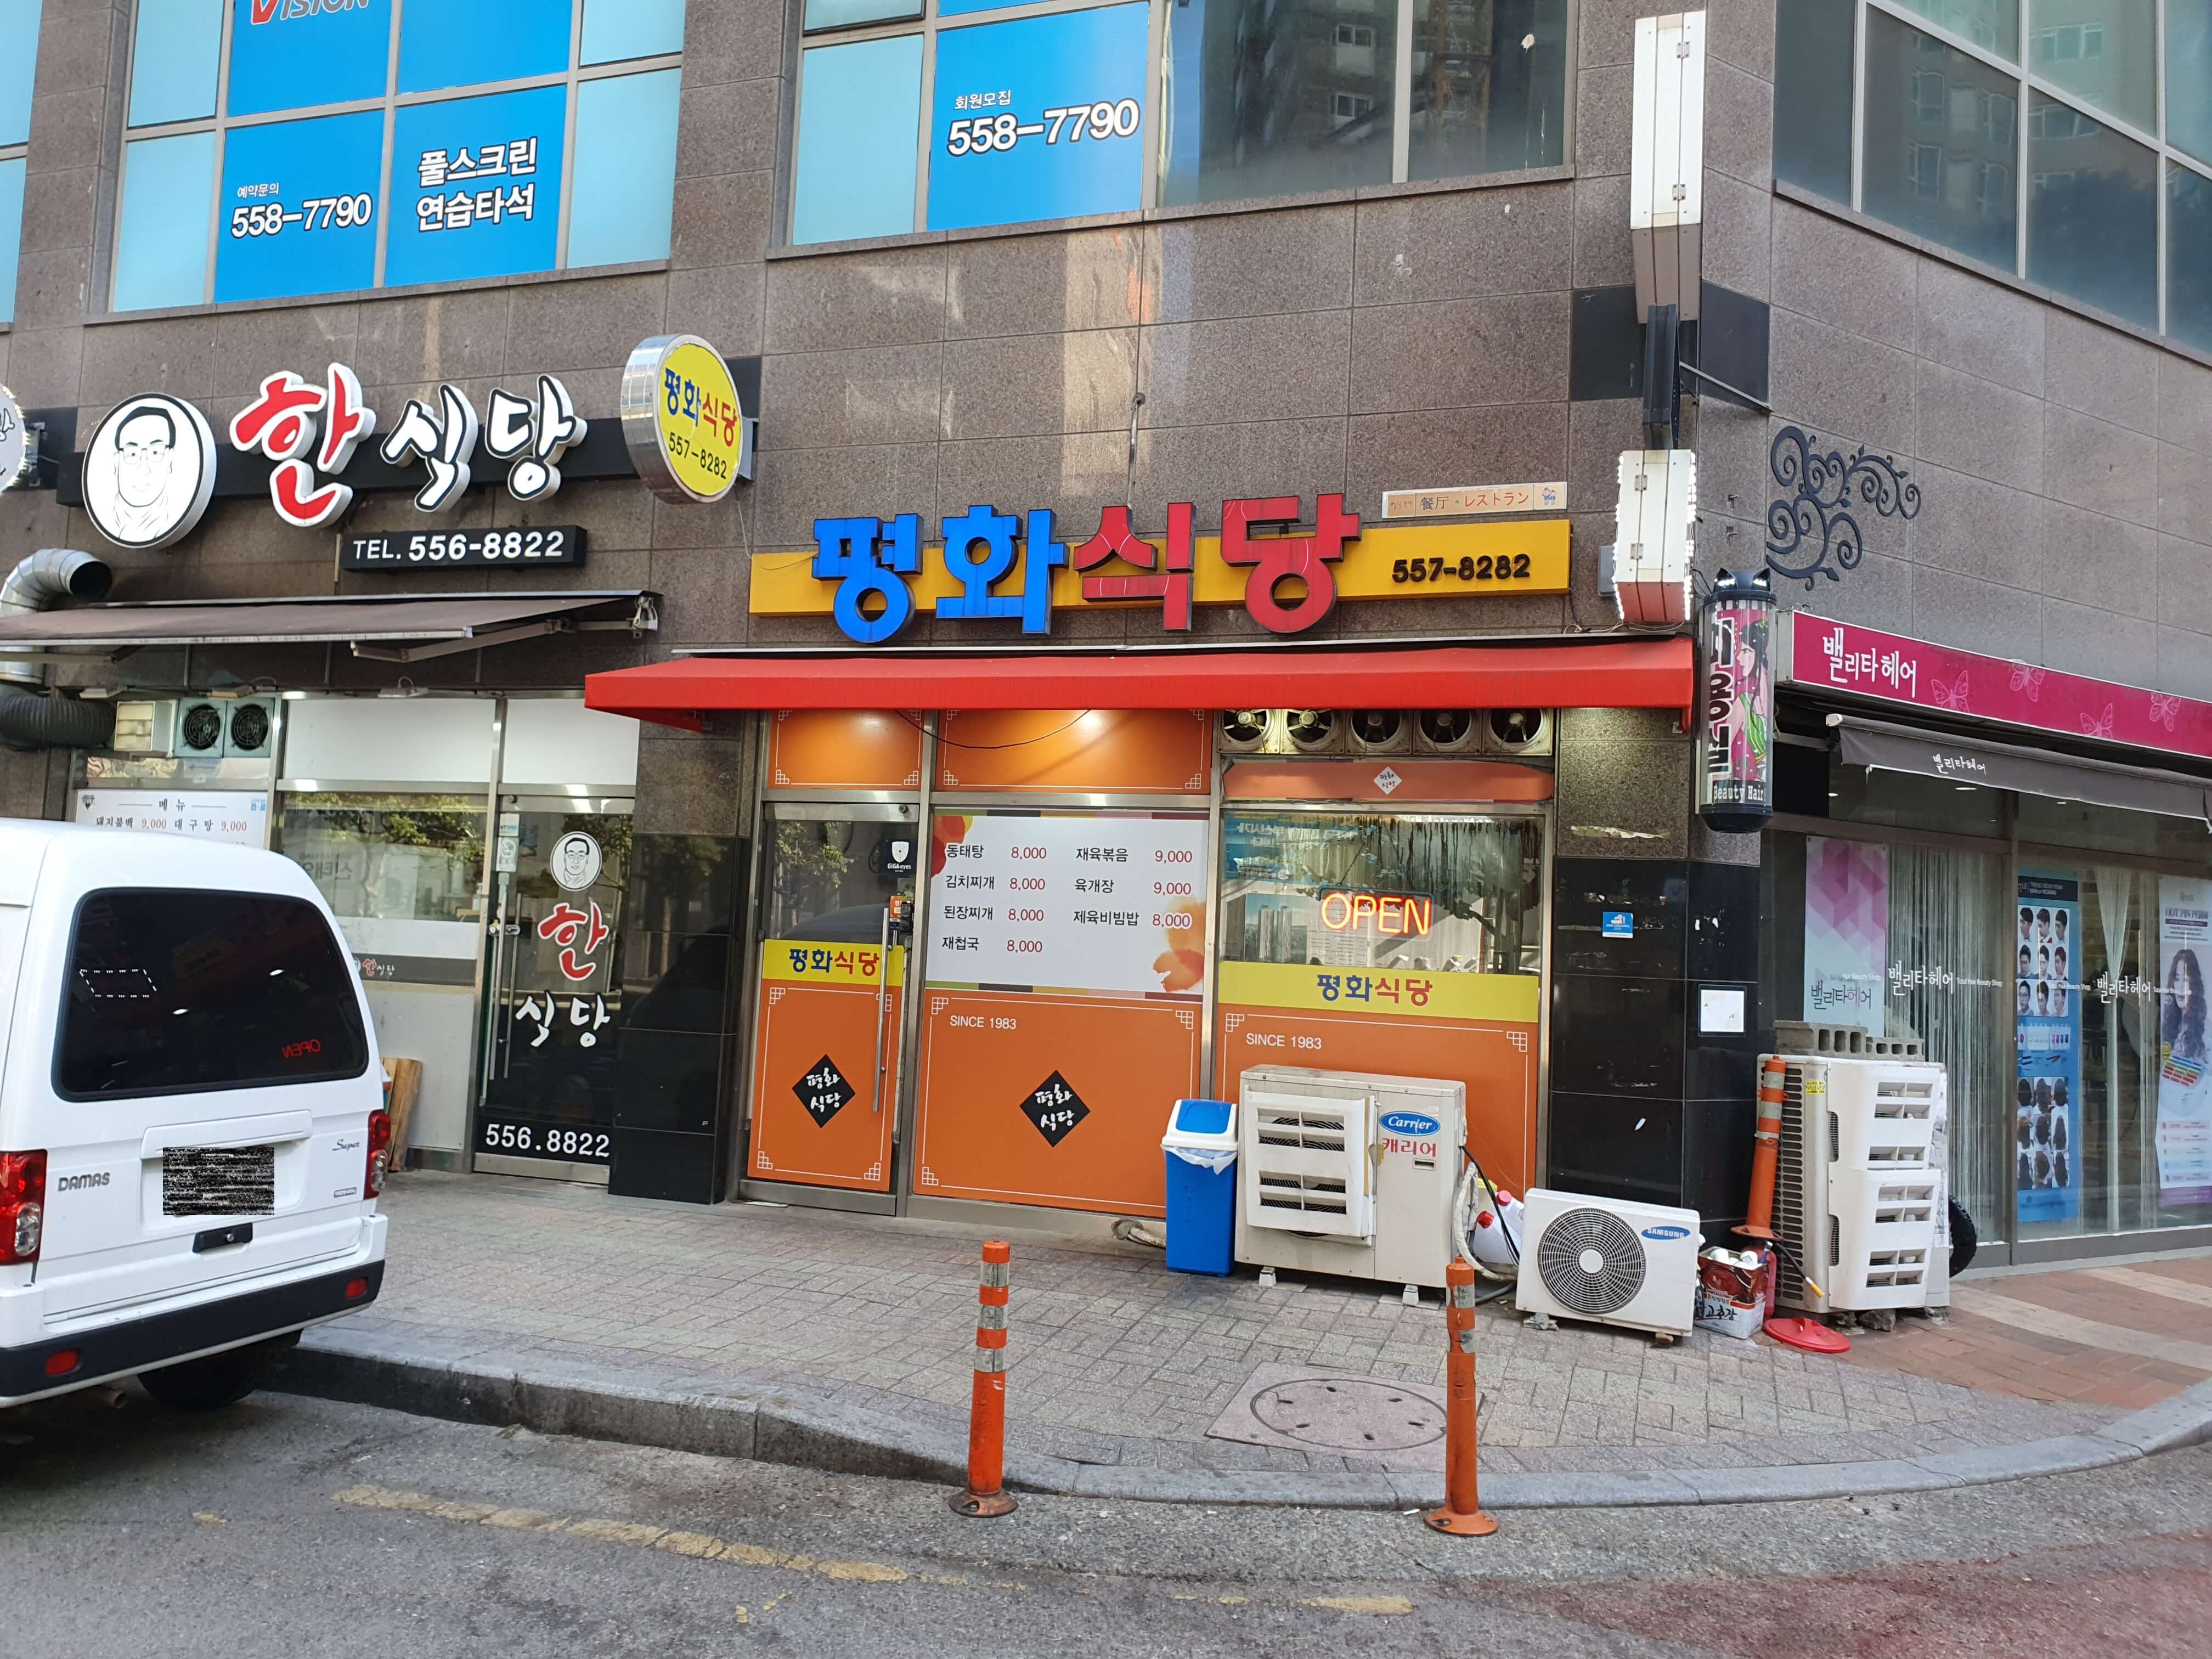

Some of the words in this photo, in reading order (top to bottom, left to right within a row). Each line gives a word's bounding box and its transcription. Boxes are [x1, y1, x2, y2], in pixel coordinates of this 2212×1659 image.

[954, 89, 1012, 111] 회원모집
[947, 98, 1140, 157] 558-7790
[418, 137, 538, 188] 풀스크린
[237, 182, 279, 199] 예약문의
[230, 193, 373, 239] 558-7790
[416, 183, 535, 233] 연습타석
[664, 368, 737, 447] 평화식당
[669, 432, 727, 479] 557-8282
[1420, 496, 1449, 511] 餐厅
[1464, 492, 1529, 507] レストラン
[353, 539, 402, 561] TEL.
[409, 530, 565, 561] 556-8822
[812, 493, 1362, 644] 평화식당
[1391, 554, 1531, 583] 557-8282
[1713, 785, 1745, 803] Beauty
[1748, 785, 1764, 801] Hair
[141, 819, 167, 830] 9,000
[221, 821, 247, 832] 9,000
[946, 844, 984, 859] 동태탕
[1011, 847, 1047, 860] 8,000
[1076, 847, 1128, 862] 재육볶음
[1155, 850, 1193, 864] 9,000
[945, 875, 995, 889] 김치찌개
[1009, 877, 1046, 891] 8,000
[1074, 878, 1114, 894] 육개장
[1154, 882, 1192, 895] 9,000
[944, 905, 994, 921] 된장찌개
[1008, 908, 1044, 922] 8,000
[1073, 910, 1139, 926] 제육비빔밥
[1152, 913, 1190, 928] 8,000
[1320, 891, 1431, 936] OPEN
[537, 896, 610, 981] 한
[941, 936, 979, 951] 재첩국
[1006, 939, 1043, 953] 8,000
[789, 949, 880, 977] 평화식당
[1888, 960, 1954, 996] 밸리타헤어
[2096, 971, 2151, 1004] 밸리타헤어
[1317, 974, 1433, 1007] 평화식당
[1810, 979, 1872, 1010] 밸리타헤어
[515, 991, 611, 1048] 식당
[950, 1015, 984, 1028] SINCE
[989, 1017, 1017, 1030] 1983
[1246, 1032, 1285, 1048] SINCE
[1290, 1035, 1322, 1050] 1983
[806, 1067, 840, 1089] 평화
[810, 1092, 842, 1113] 식당
[1035, 1084, 1073, 1107] 평화
[1041, 1110, 1075, 1131] 식당
[1388, 1116, 1432, 1130] Carrier
[486, 1123, 610, 1158] 556.8822
[1382, 1138, 1436, 1158] 캐리어
[58, 1172, 111, 1192] DAMAS
[1647, 1228, 1685, 1238] SAMSUNG
